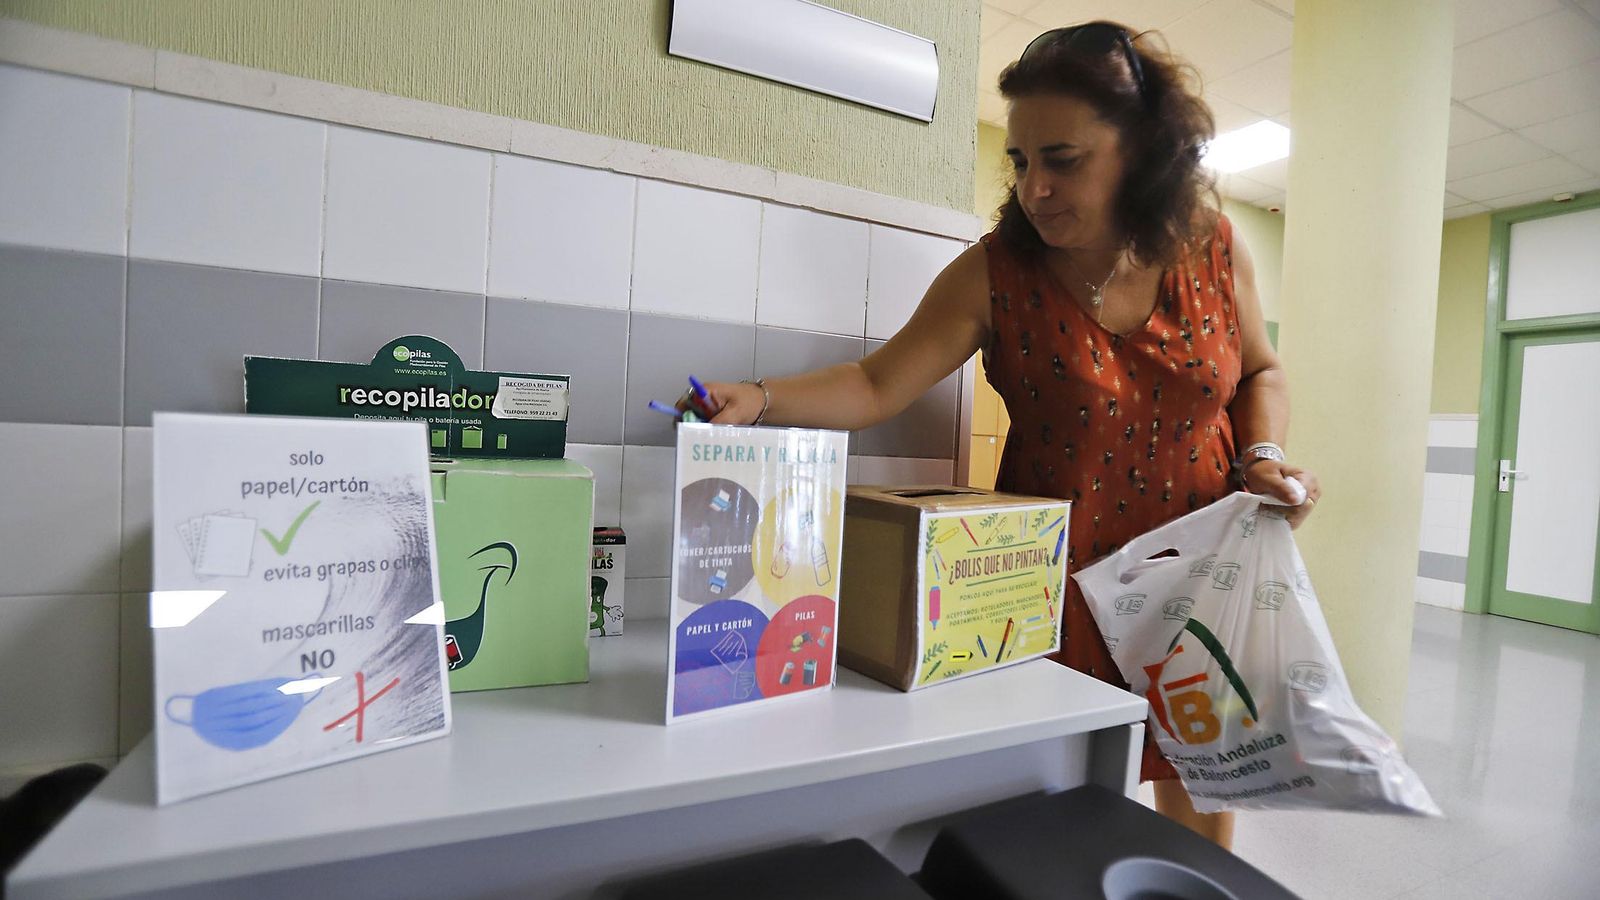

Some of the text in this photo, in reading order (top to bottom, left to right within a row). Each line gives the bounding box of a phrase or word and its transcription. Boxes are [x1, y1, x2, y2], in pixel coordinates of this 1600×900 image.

[393, 368, 447, 376] www.ecopilas.es
[340, 387, 494, 412] recopilador
[289, 450, 324, 466] solo
[693, 444, 756, 462] SEPARA
[764, 446, 772, 462] Y
[241, 476, 369, 499] papel/cartón
[263, 562, 311, 582] evita
[317, 559, 376, 582] grapas
[380, 559, 389, 571] o
[591, 559, 613, 569] ILAS
[699, 558, 733, 568] DE TINTA
[948, 547, 1048, 585] ¿BOLIS QUE NO PINTAN?
[686, 617, 753, 636] PAPEL Y CARTÓN
[795, 610, 816, 621] PILAS
[262, 614, 375, 644] mascarillas
[300, 649, 335, 673] NO
[1218, 733, 1287, 765] Andaluza
[1187, 759, 1272, 782] de Baloncesto
